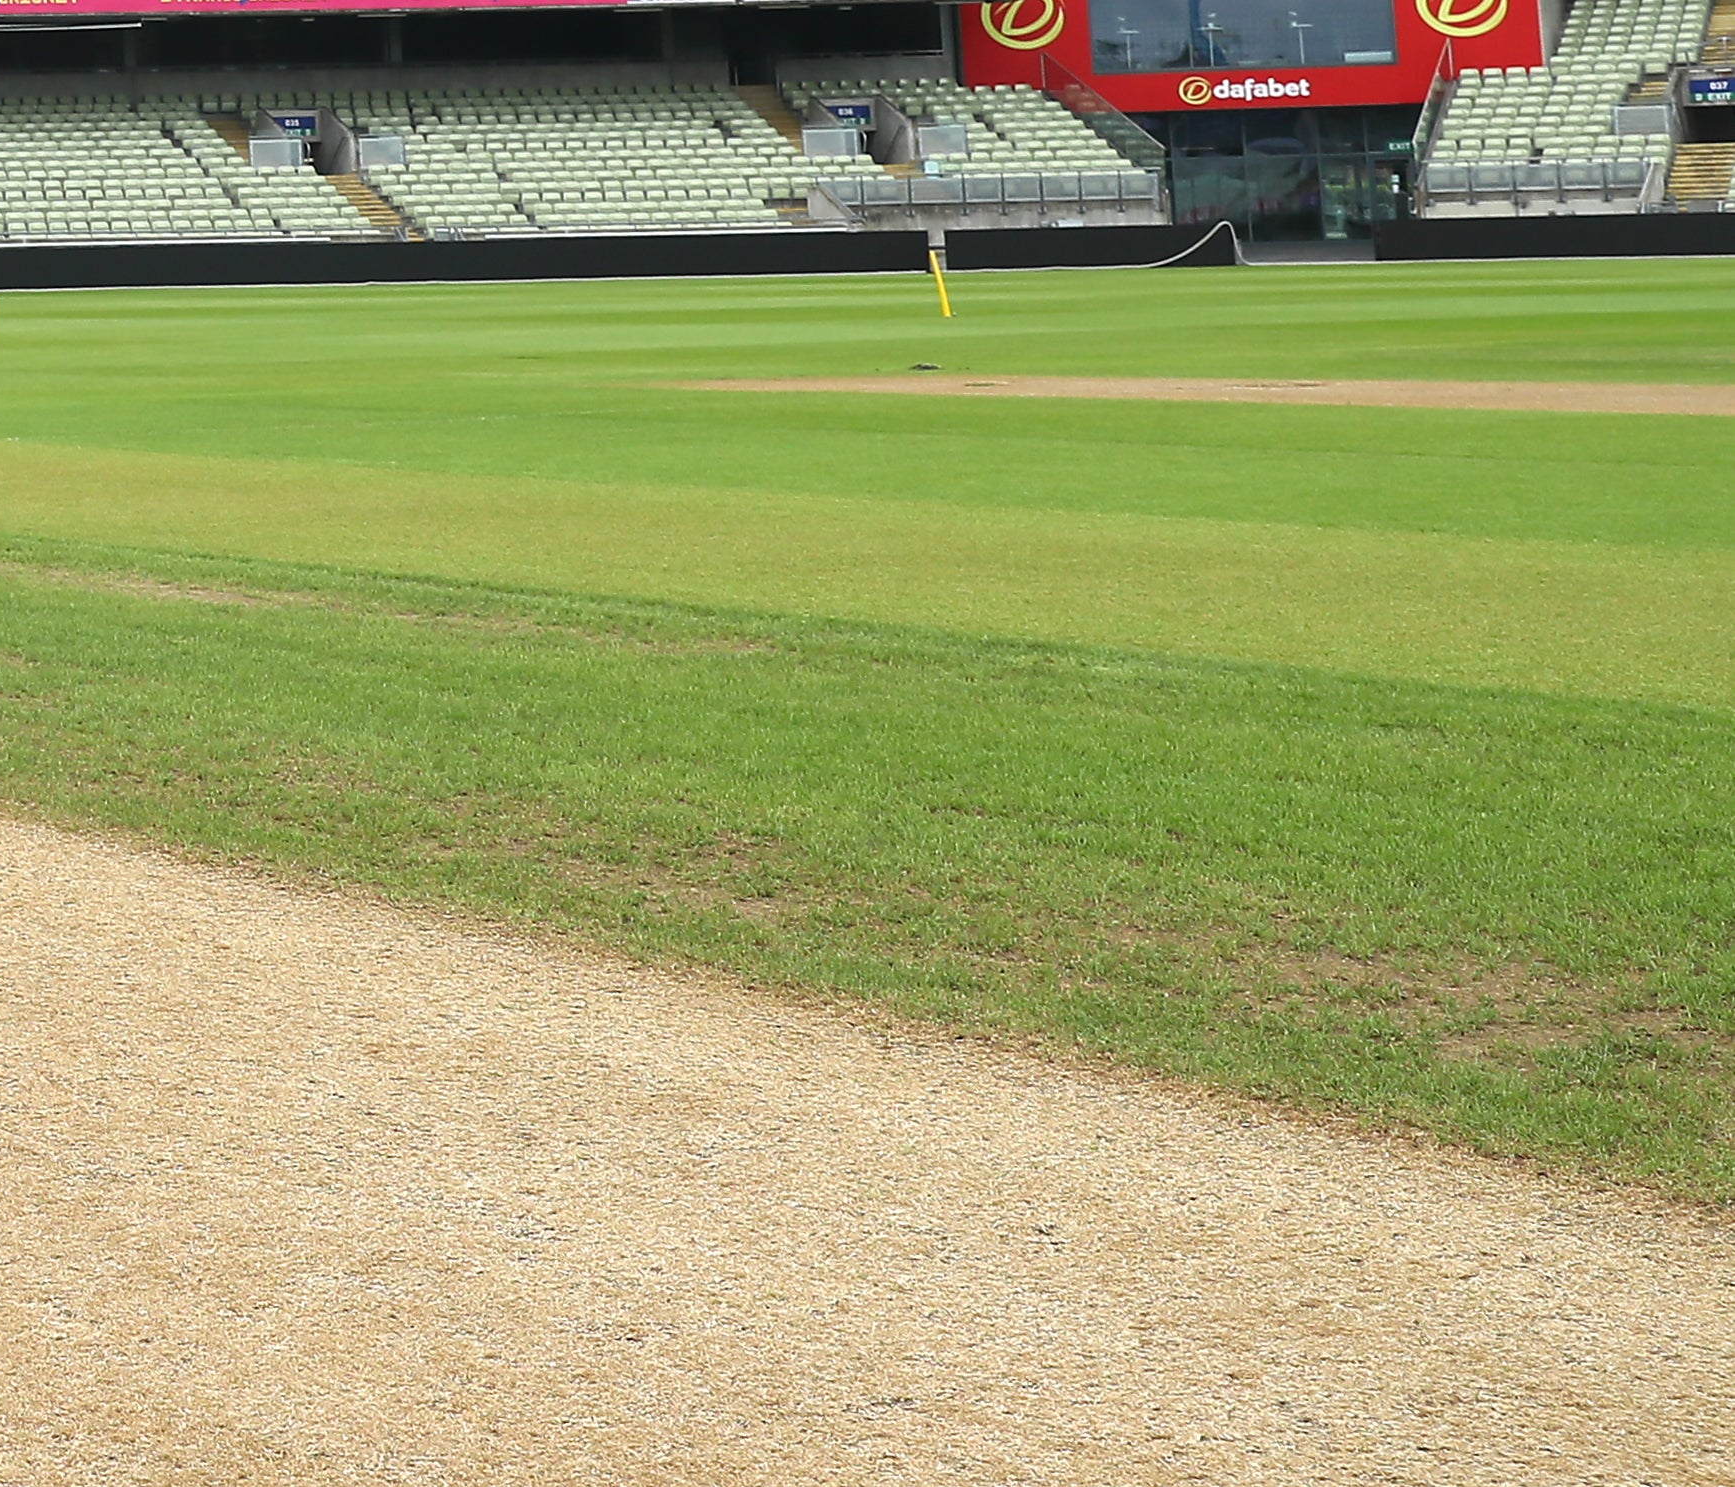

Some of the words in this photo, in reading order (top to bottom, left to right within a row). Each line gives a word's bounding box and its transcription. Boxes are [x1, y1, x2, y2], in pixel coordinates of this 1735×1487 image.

[1212, 77, 1310, 102] dafabet
[1709, 81, 1729, 91] 037
[1707, 92, 1732, 101] EXIT
[1388, 142, 1411, 151] EXIT
